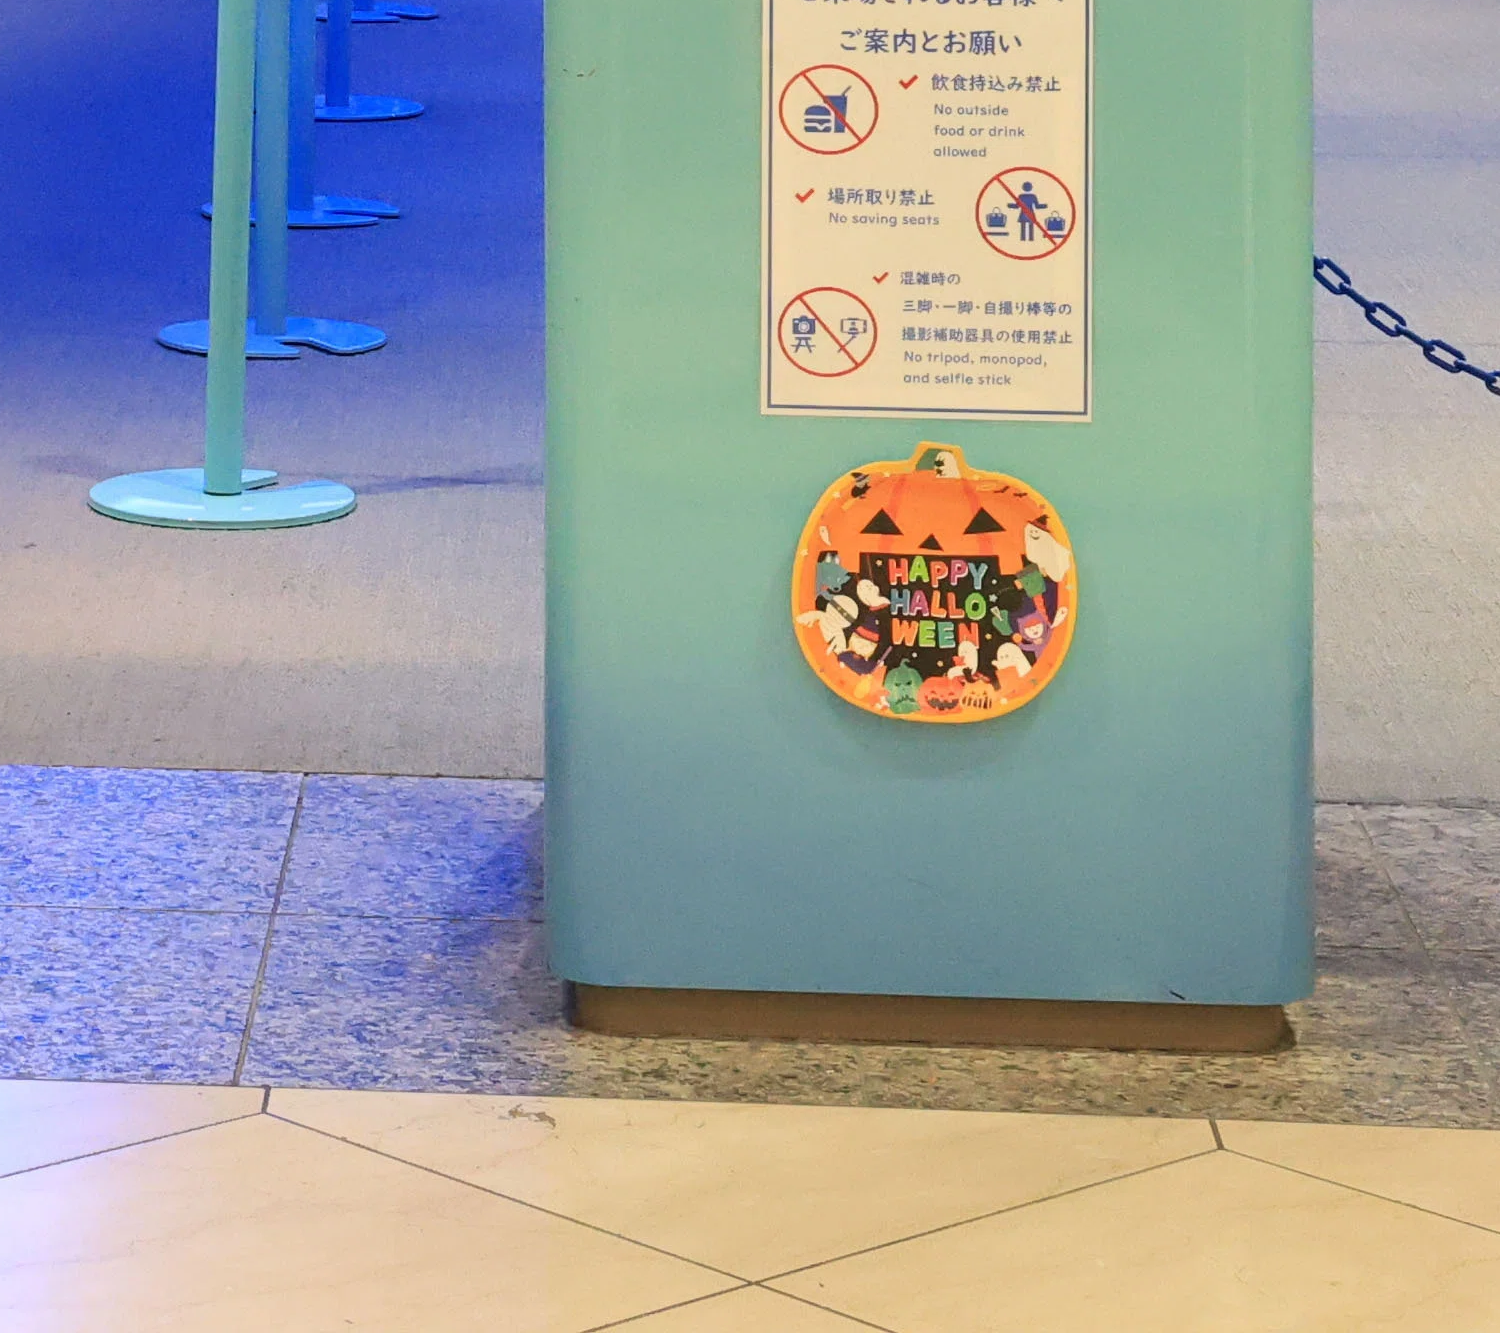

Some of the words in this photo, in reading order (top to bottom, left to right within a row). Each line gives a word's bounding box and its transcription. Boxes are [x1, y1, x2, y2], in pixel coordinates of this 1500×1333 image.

[840, 28, 1022, 55] ご案内とお願い
[931, 74, 1062, 93] 飲食持込み禁止
[934, 104, 952, 116] No
[957, 104, 1009, 117] outside
[934, 125, 966, 138] food
[969, 127, 985, 138] or
[988, 125, 1025, 138] drink
[933, 146, 987, 158] allowed
[828, 188, 935, 206] 場所取り禁止
[829, 212, 847, 224] No
[851, 212, 897, 227] saving
[902, 213, 940, 226] seats
[900, 271, 961, 286] 混雑時の
[902, 300, 1072, 317] 三脚・一脚・自撮り棒等の
[901, 327, 1073, 345] 撮影補助器具の使用禁止
[904, 351, 922, 364] No
[927, 351, 975, 367] tripod,
[980, 353, 1048, 367] monopod,
[904, 372, 930, 384] and
[935, 372, 974, 385] selfie
[978, 373, 1012, 386] stick
[888, 555, 989, 591] HAPPY
[889, 588, 988, 621] HALLO
[891, 619, 980, 649] WEEN
